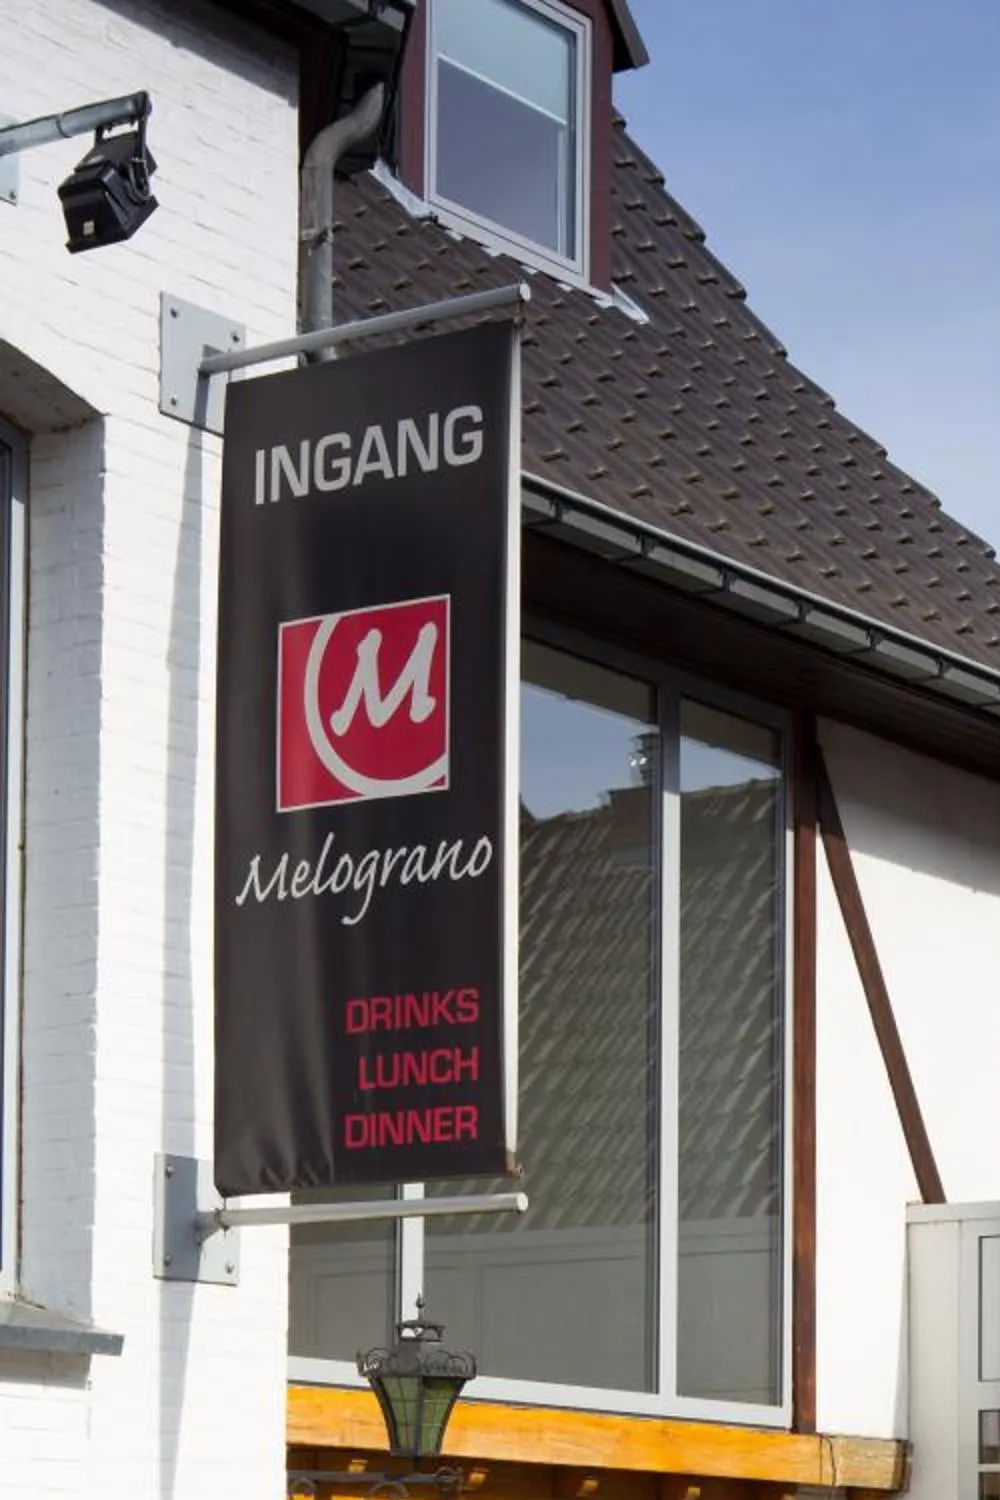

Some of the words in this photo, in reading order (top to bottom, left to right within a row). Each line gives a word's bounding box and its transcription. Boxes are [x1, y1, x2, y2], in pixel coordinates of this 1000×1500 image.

[255, 405, 483, 505] INGANG
[235, 831, 493, 926] Melograno
[345, 988, 480, 1035] DRINKS
[358, 1046, 480, 1090] LUNCH
[343, 1104, 479, 1151] DINNER
